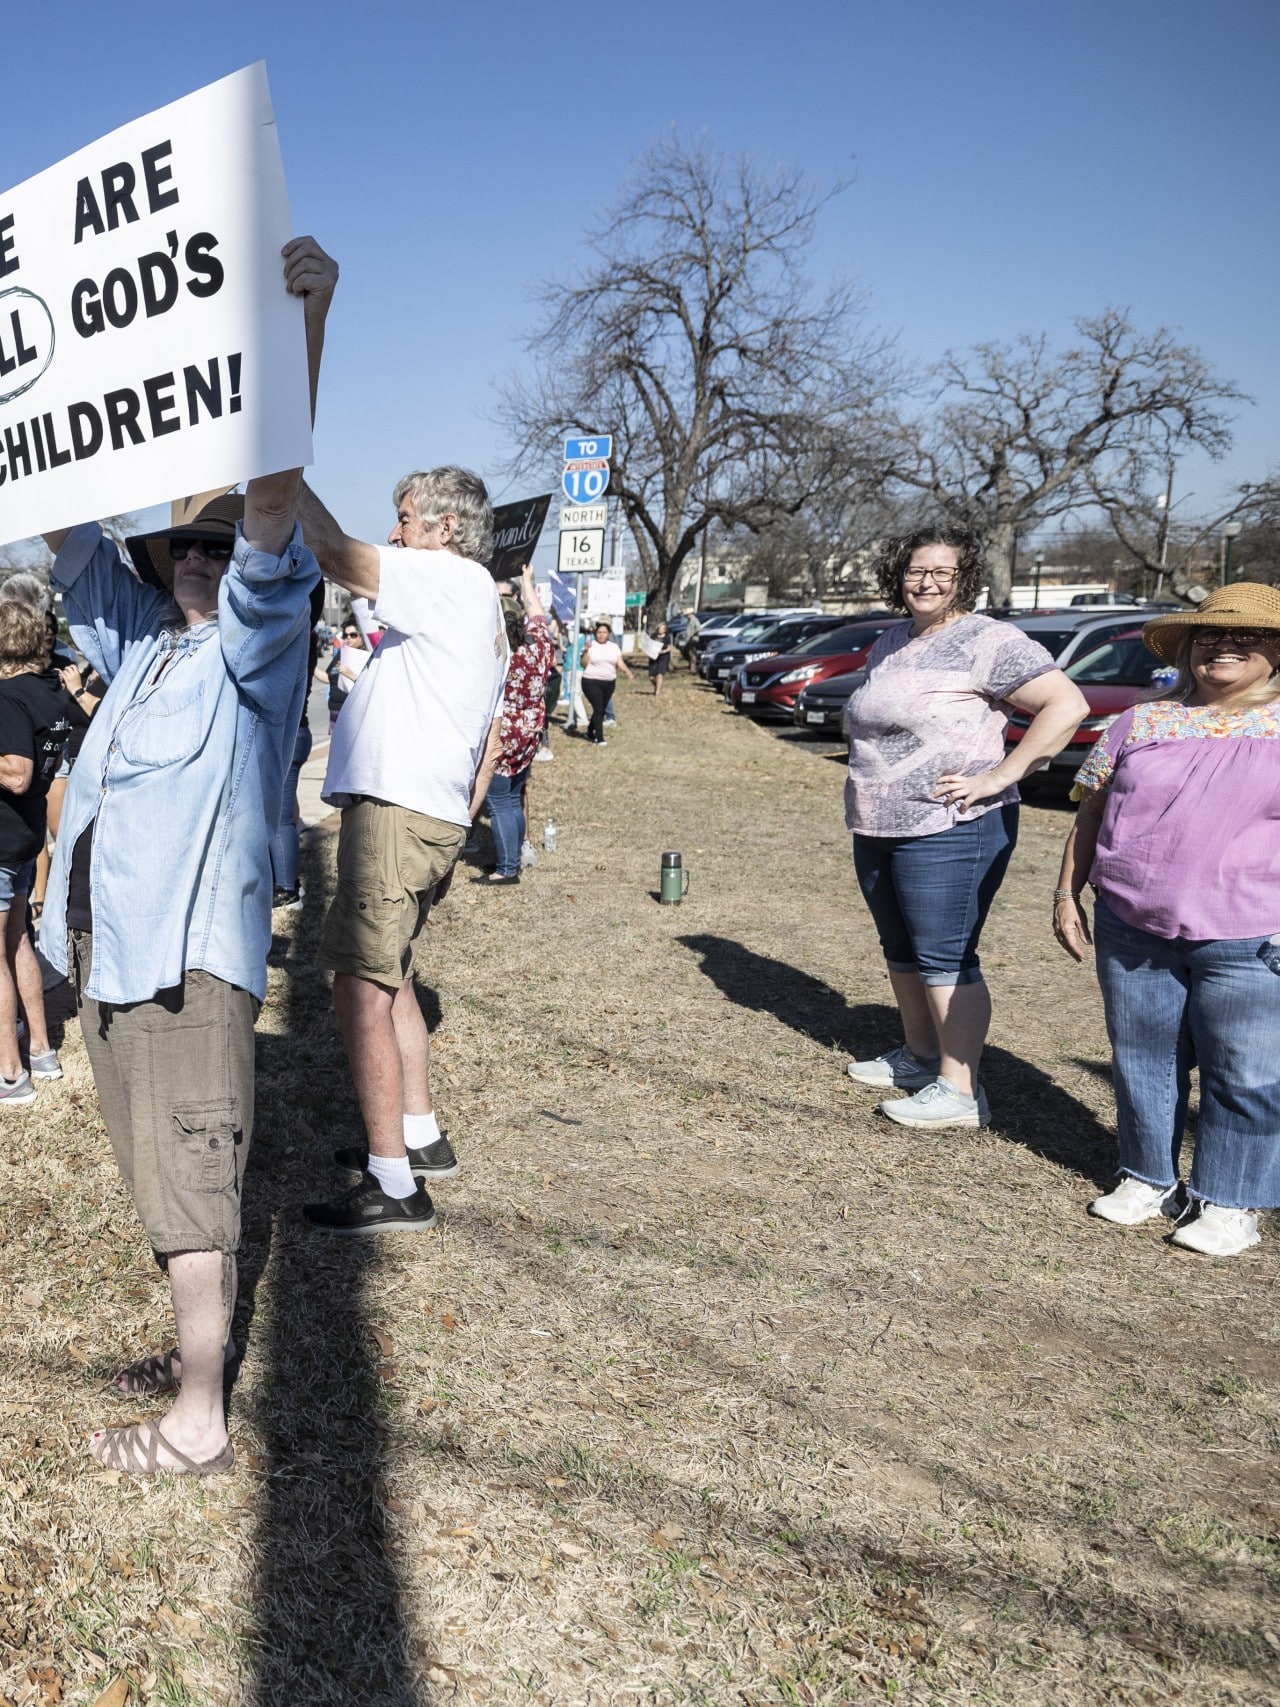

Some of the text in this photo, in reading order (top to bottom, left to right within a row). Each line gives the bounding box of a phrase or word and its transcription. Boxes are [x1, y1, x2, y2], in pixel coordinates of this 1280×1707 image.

[73, 139, 180, 245] ARE
[71, 229, 225, 339] GOD'S
[578, 441, 598, 456] TO
[571, 470, 603, 497] 10
[491, 502, 541, 552] manity
[564, 510, 604, 523] NORTH
[573, 535, 591, 553] 16
[566, 556, 596, 566] TEXAS
